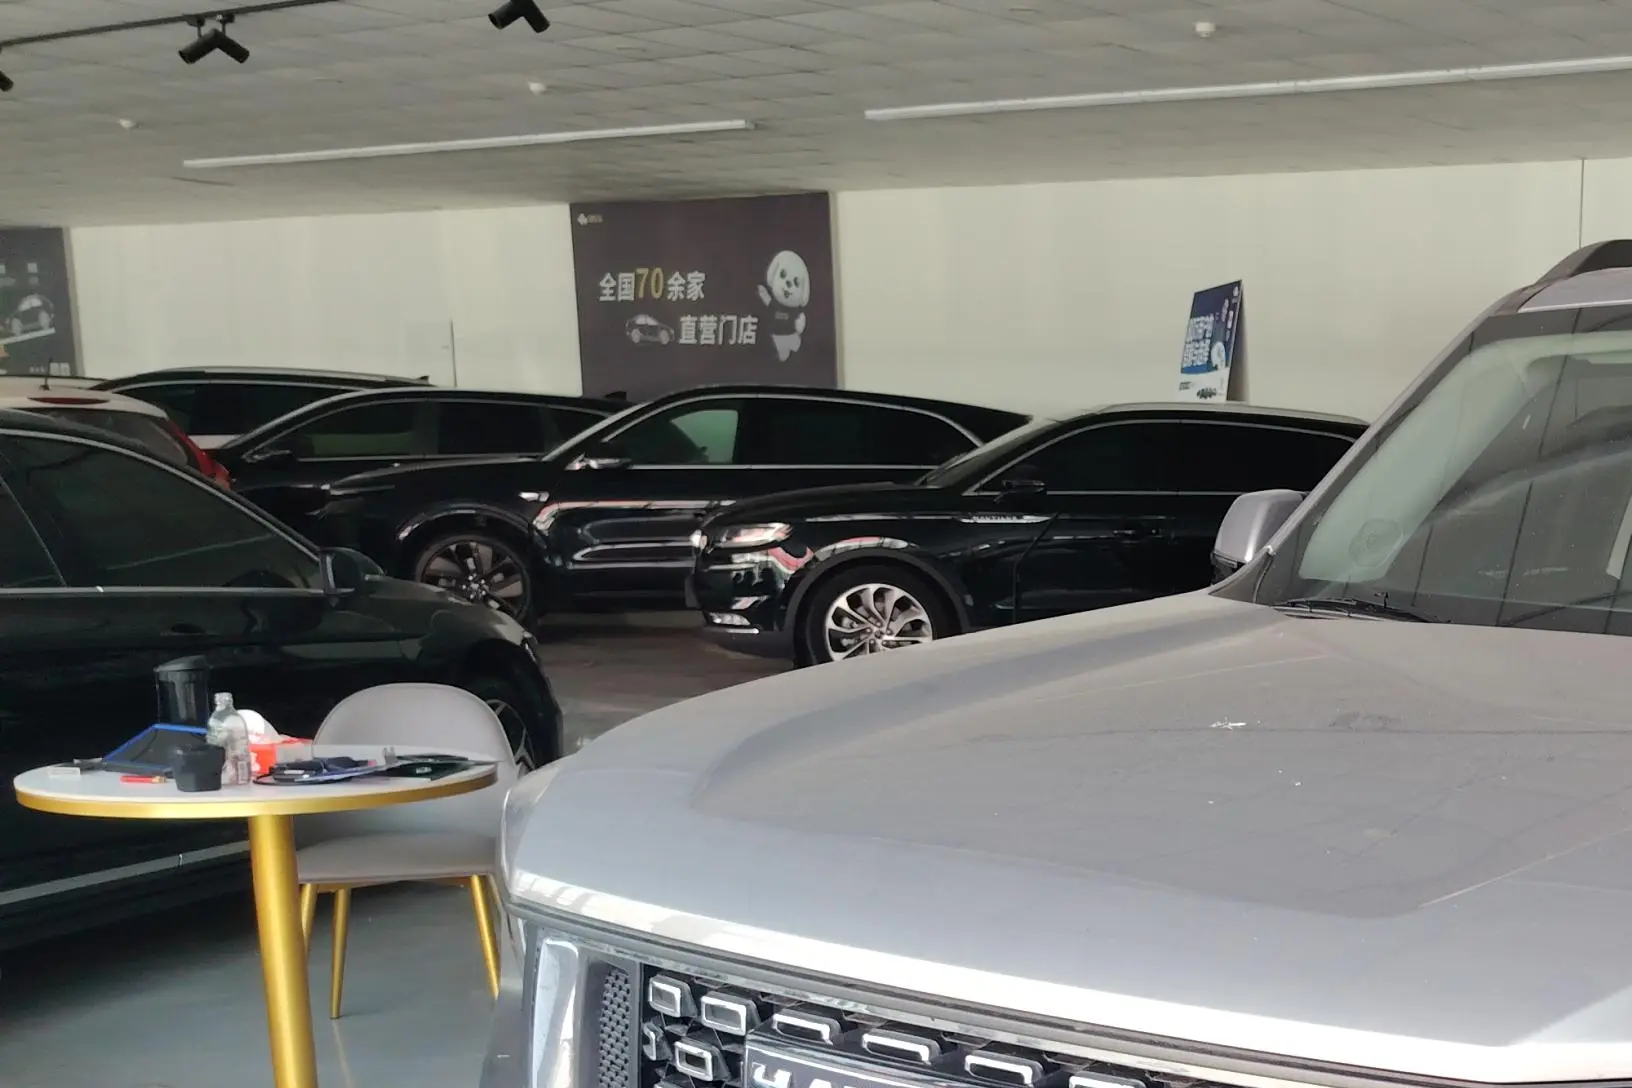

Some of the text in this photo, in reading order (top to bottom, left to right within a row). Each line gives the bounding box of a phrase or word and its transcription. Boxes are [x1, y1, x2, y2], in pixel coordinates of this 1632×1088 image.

[599, 267, 706, 301] 全国70余家
[678, 314, 759, 345] 直营门店
